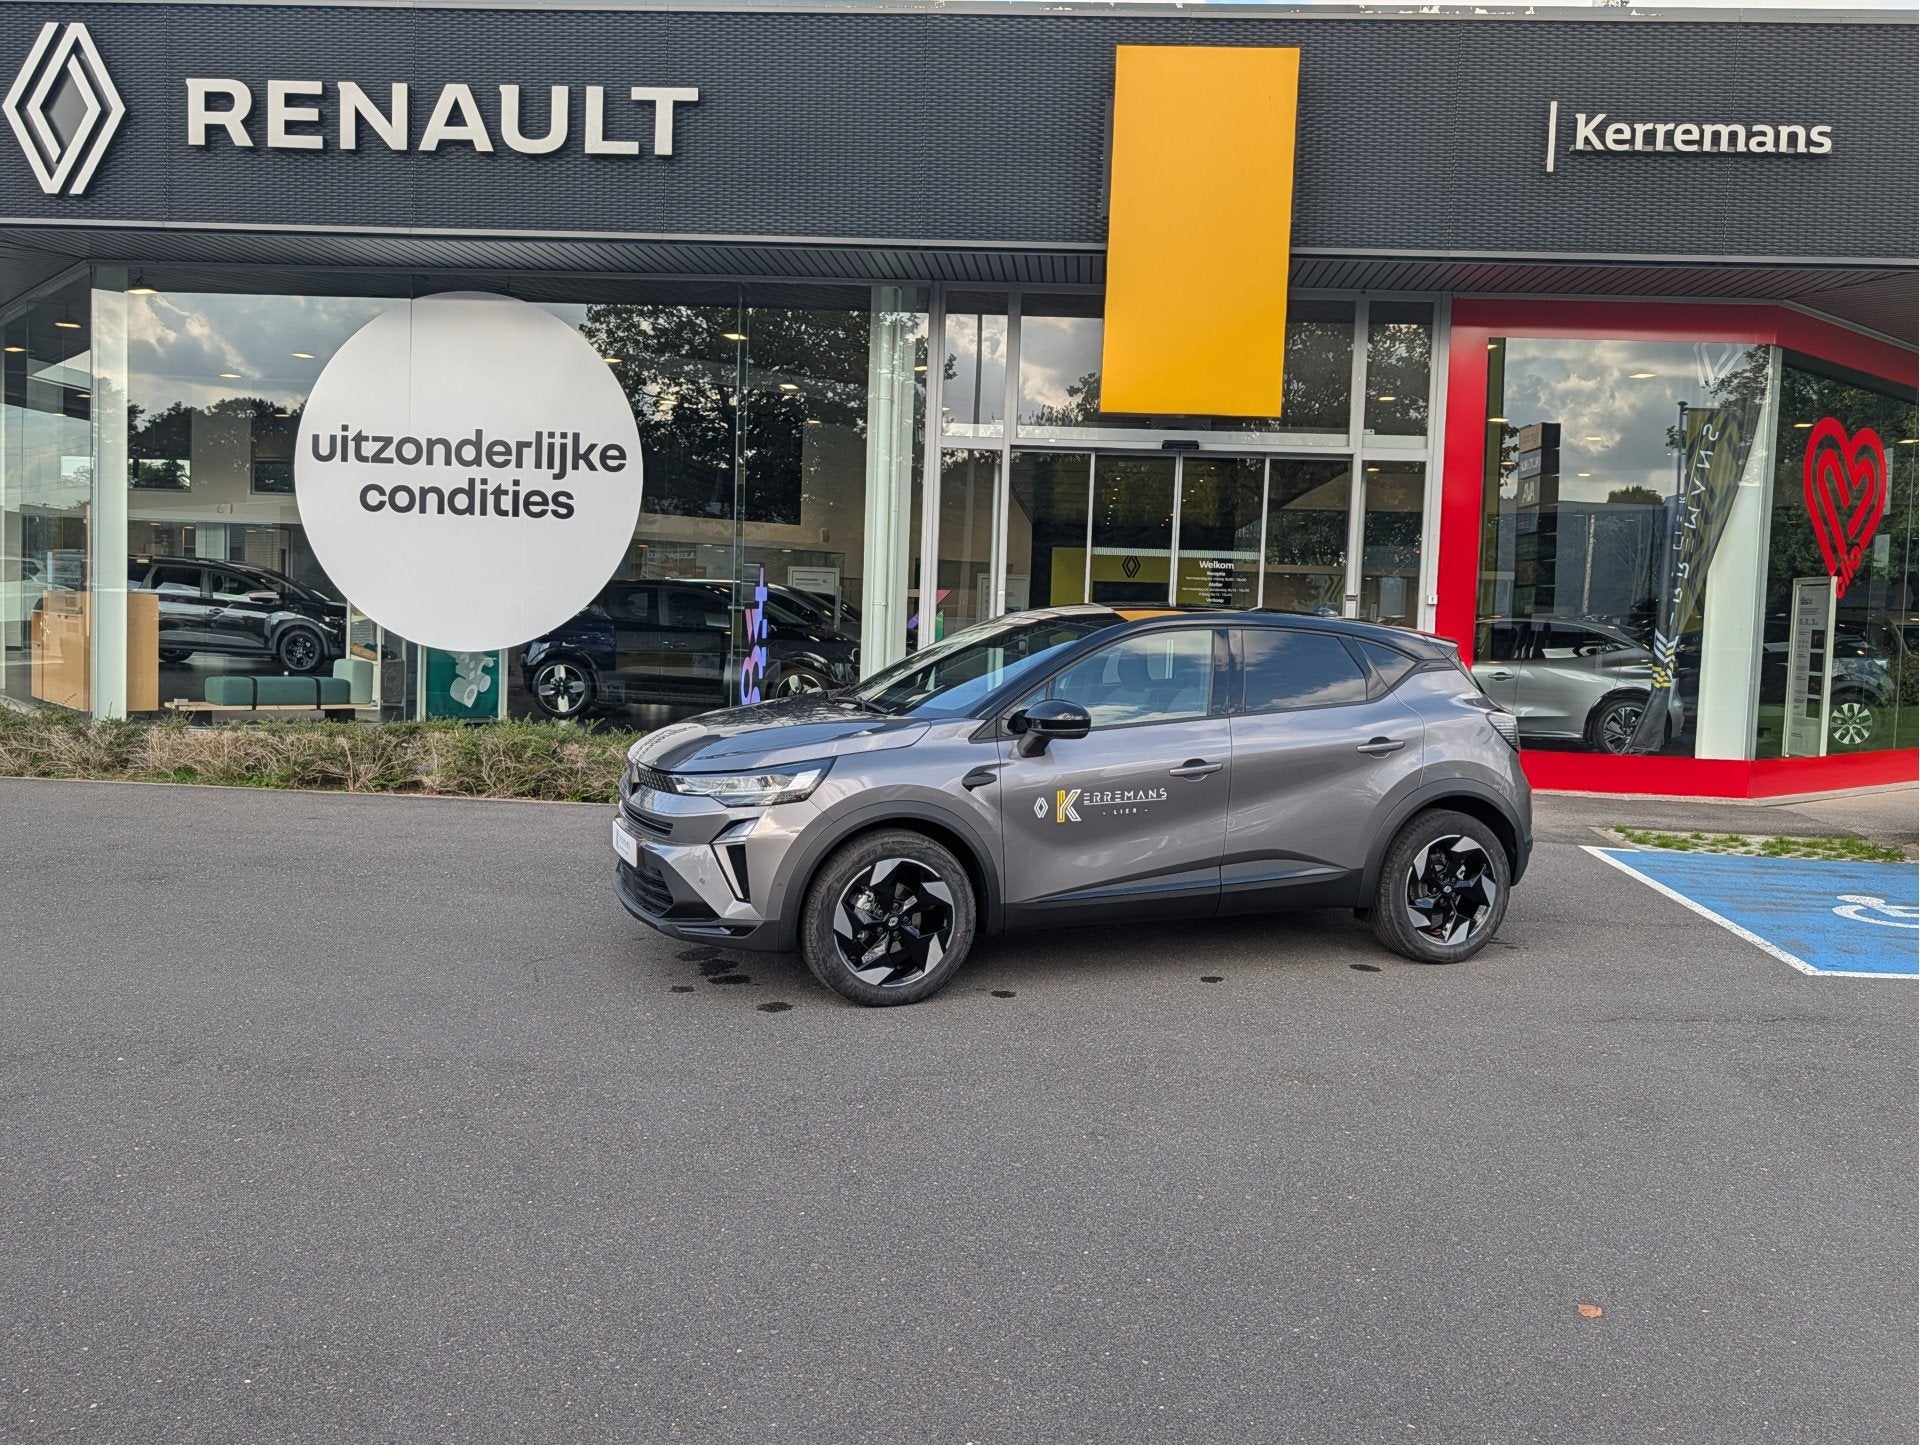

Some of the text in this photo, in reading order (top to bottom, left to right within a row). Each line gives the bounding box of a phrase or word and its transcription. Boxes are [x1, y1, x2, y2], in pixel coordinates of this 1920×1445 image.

[186, 78, 699, 157] RENAULT
[1575, 113, 1833, 155] Kerremans
[311, 424, 628, 481] uitzonderlijke
[359, 477, 575, 520] condities
[1199, 560, 1235, 570] Welkom
